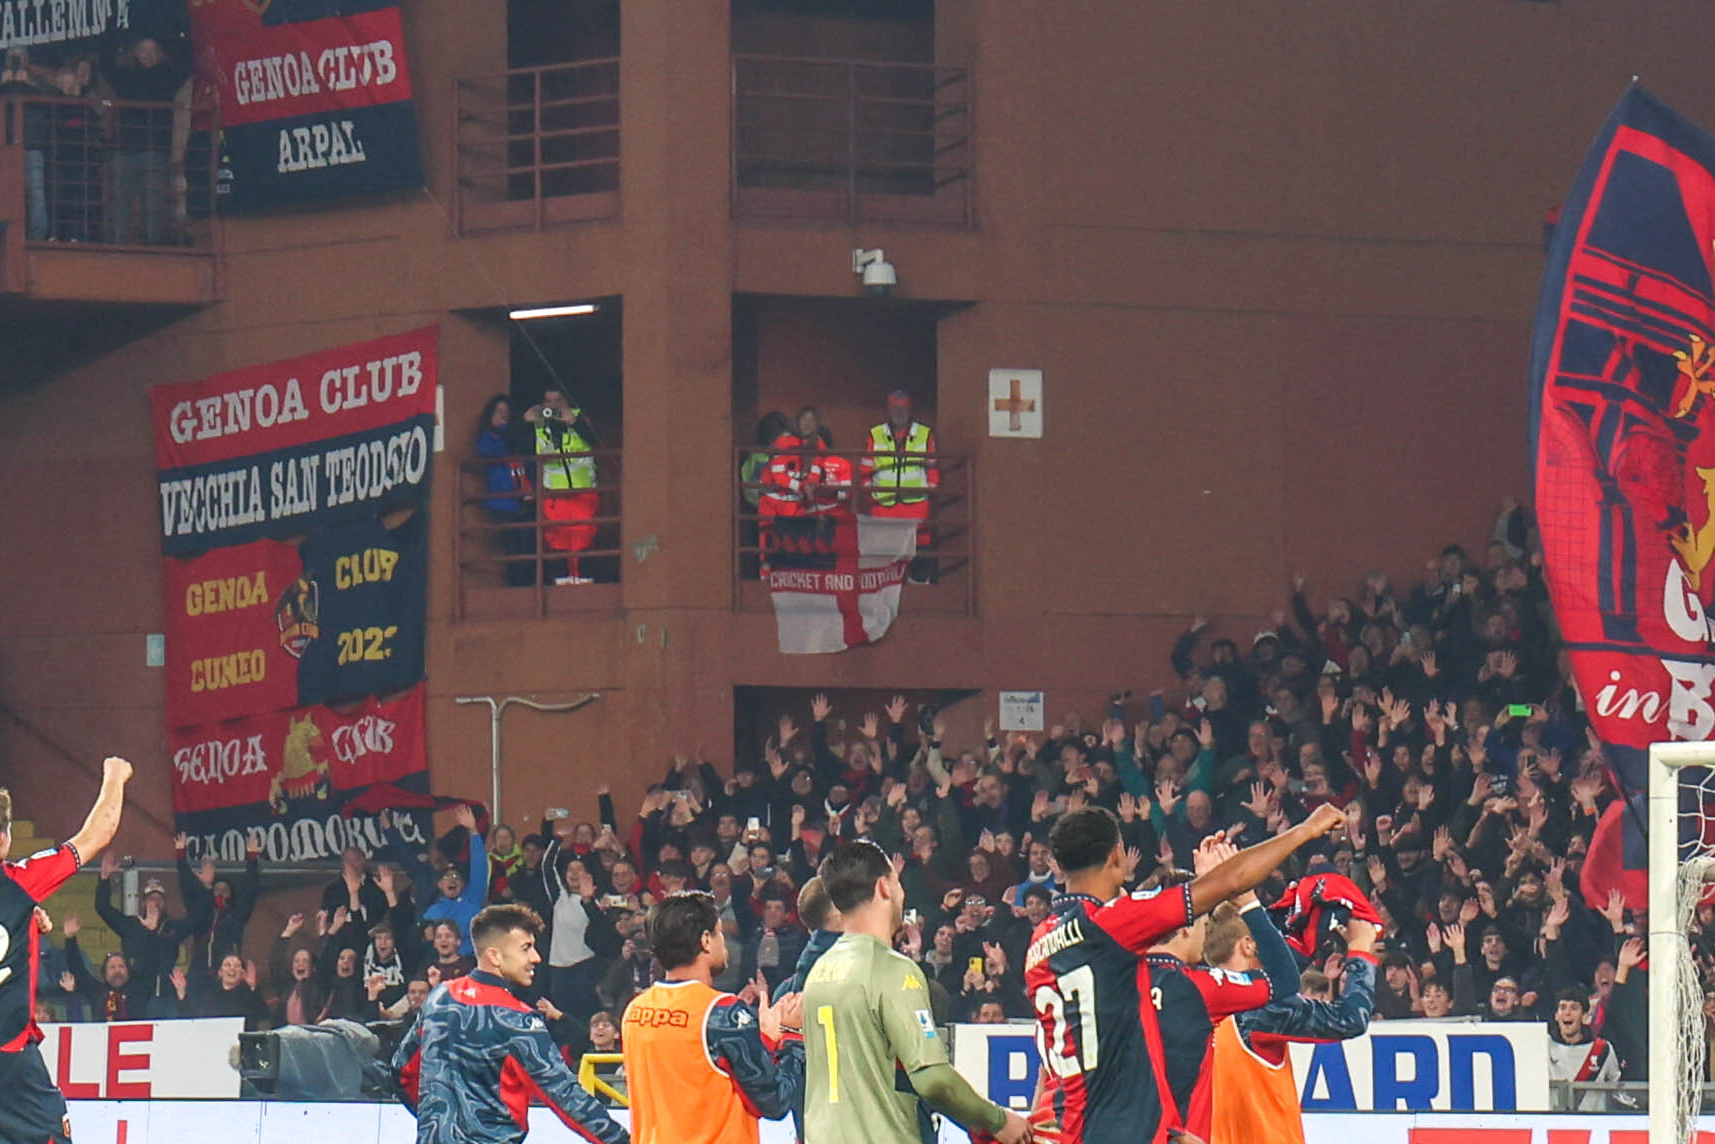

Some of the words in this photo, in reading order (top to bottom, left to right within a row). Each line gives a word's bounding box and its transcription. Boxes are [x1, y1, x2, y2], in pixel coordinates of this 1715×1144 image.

[235, 51, 320, 105] GENOA
[318, 40, 397, 91] CLUB
[277, 121, 366, 173] ARPAL
[170, 378, 310, 444] GENOA
[319, 350, 423, 414] CLUB
[160, 465, 266, 537] VECCHIA
[270, 454, 321, 520] SAN
[186, 571, 269, 617] GENOA
[769, 571, 821, 590] CRICKET
[824, 573, 854, 592] AND
[190, 649, 266, 693] CUNEO
[1596, 670, 1670, 724] in
[627, 1006, 689, 1028] appa
[817, 1005, 840, 1104] 1
